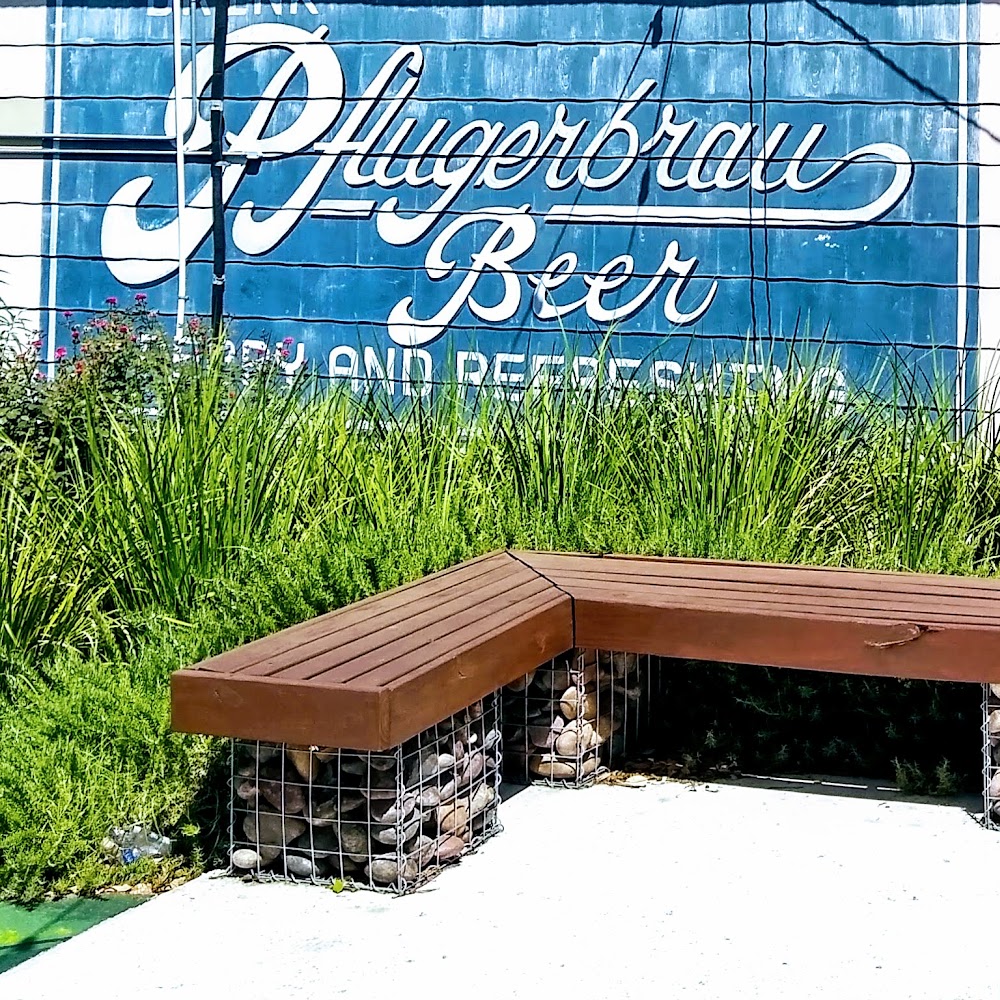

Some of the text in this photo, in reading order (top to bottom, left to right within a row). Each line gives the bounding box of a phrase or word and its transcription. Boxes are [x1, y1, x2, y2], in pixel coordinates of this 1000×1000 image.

[100, 22, 913, 286] Pflugerbrau
[387, 202, 718, 347] Beer
[328, 345, 433, 396] AND
